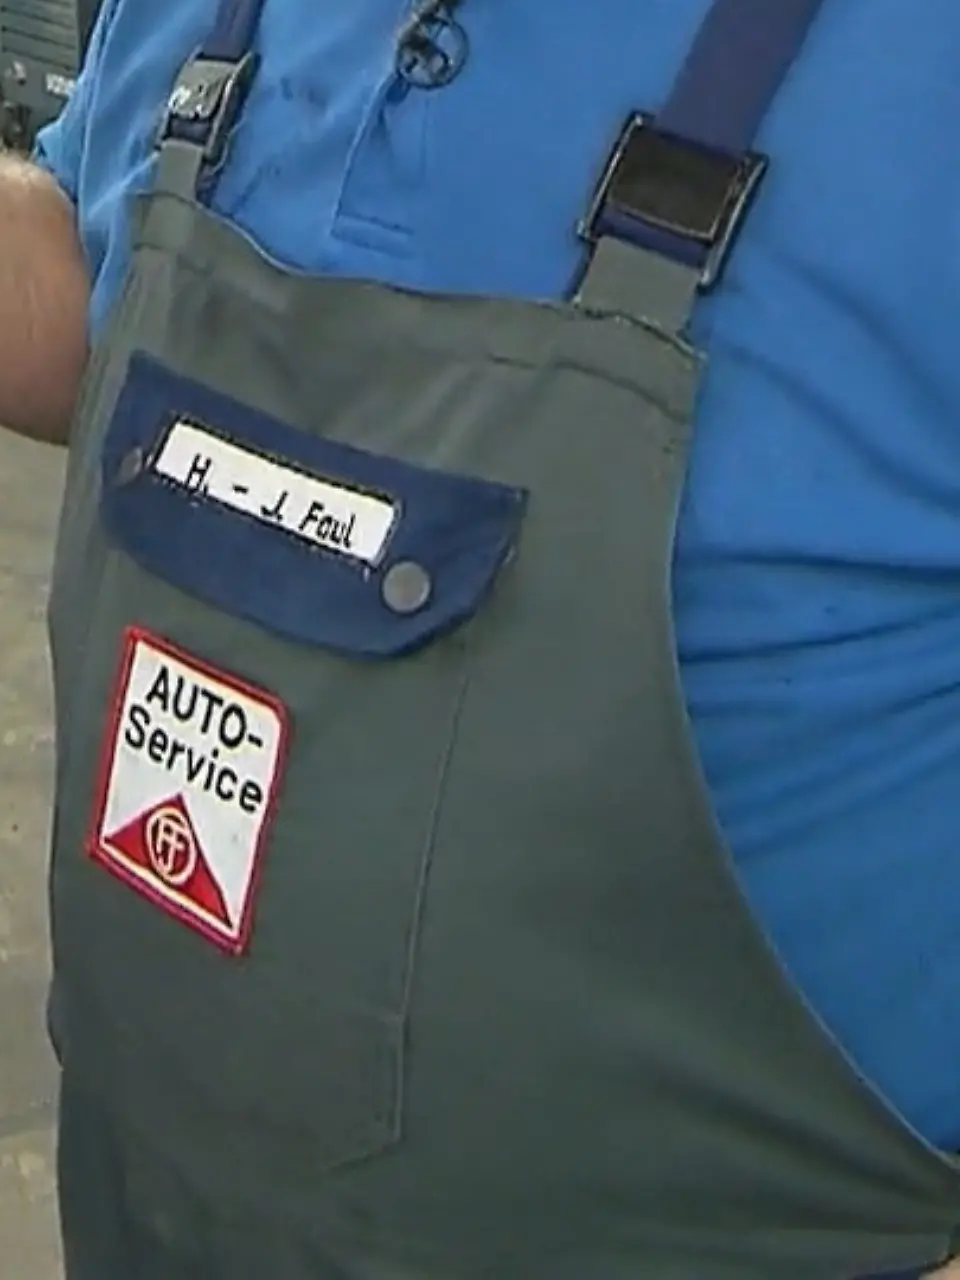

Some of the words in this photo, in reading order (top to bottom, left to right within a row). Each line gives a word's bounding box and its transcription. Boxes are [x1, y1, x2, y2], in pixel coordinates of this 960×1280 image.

[185, 451, 212, 497] H.
[259, 490, 289, 523] J.
[145, 664, 265, 750] AUTO-
[124, 703, 264, 814] Service
